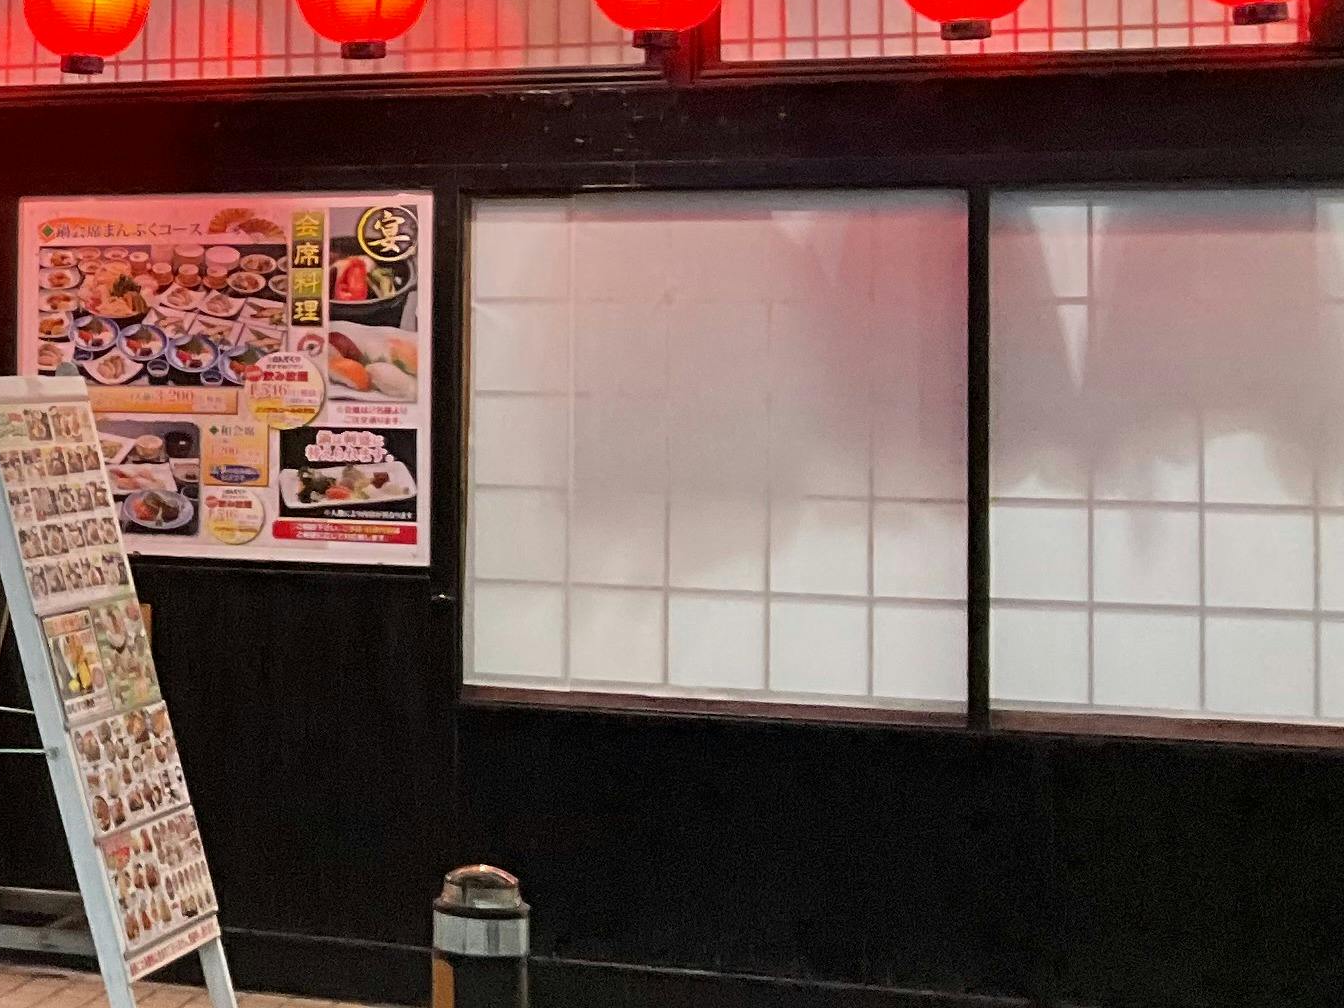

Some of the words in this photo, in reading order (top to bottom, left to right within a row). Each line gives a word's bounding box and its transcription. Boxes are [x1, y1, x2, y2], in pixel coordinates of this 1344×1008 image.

[293, 213, 322, 323] 会席料理
[368, 210, 408, 253] 宴
